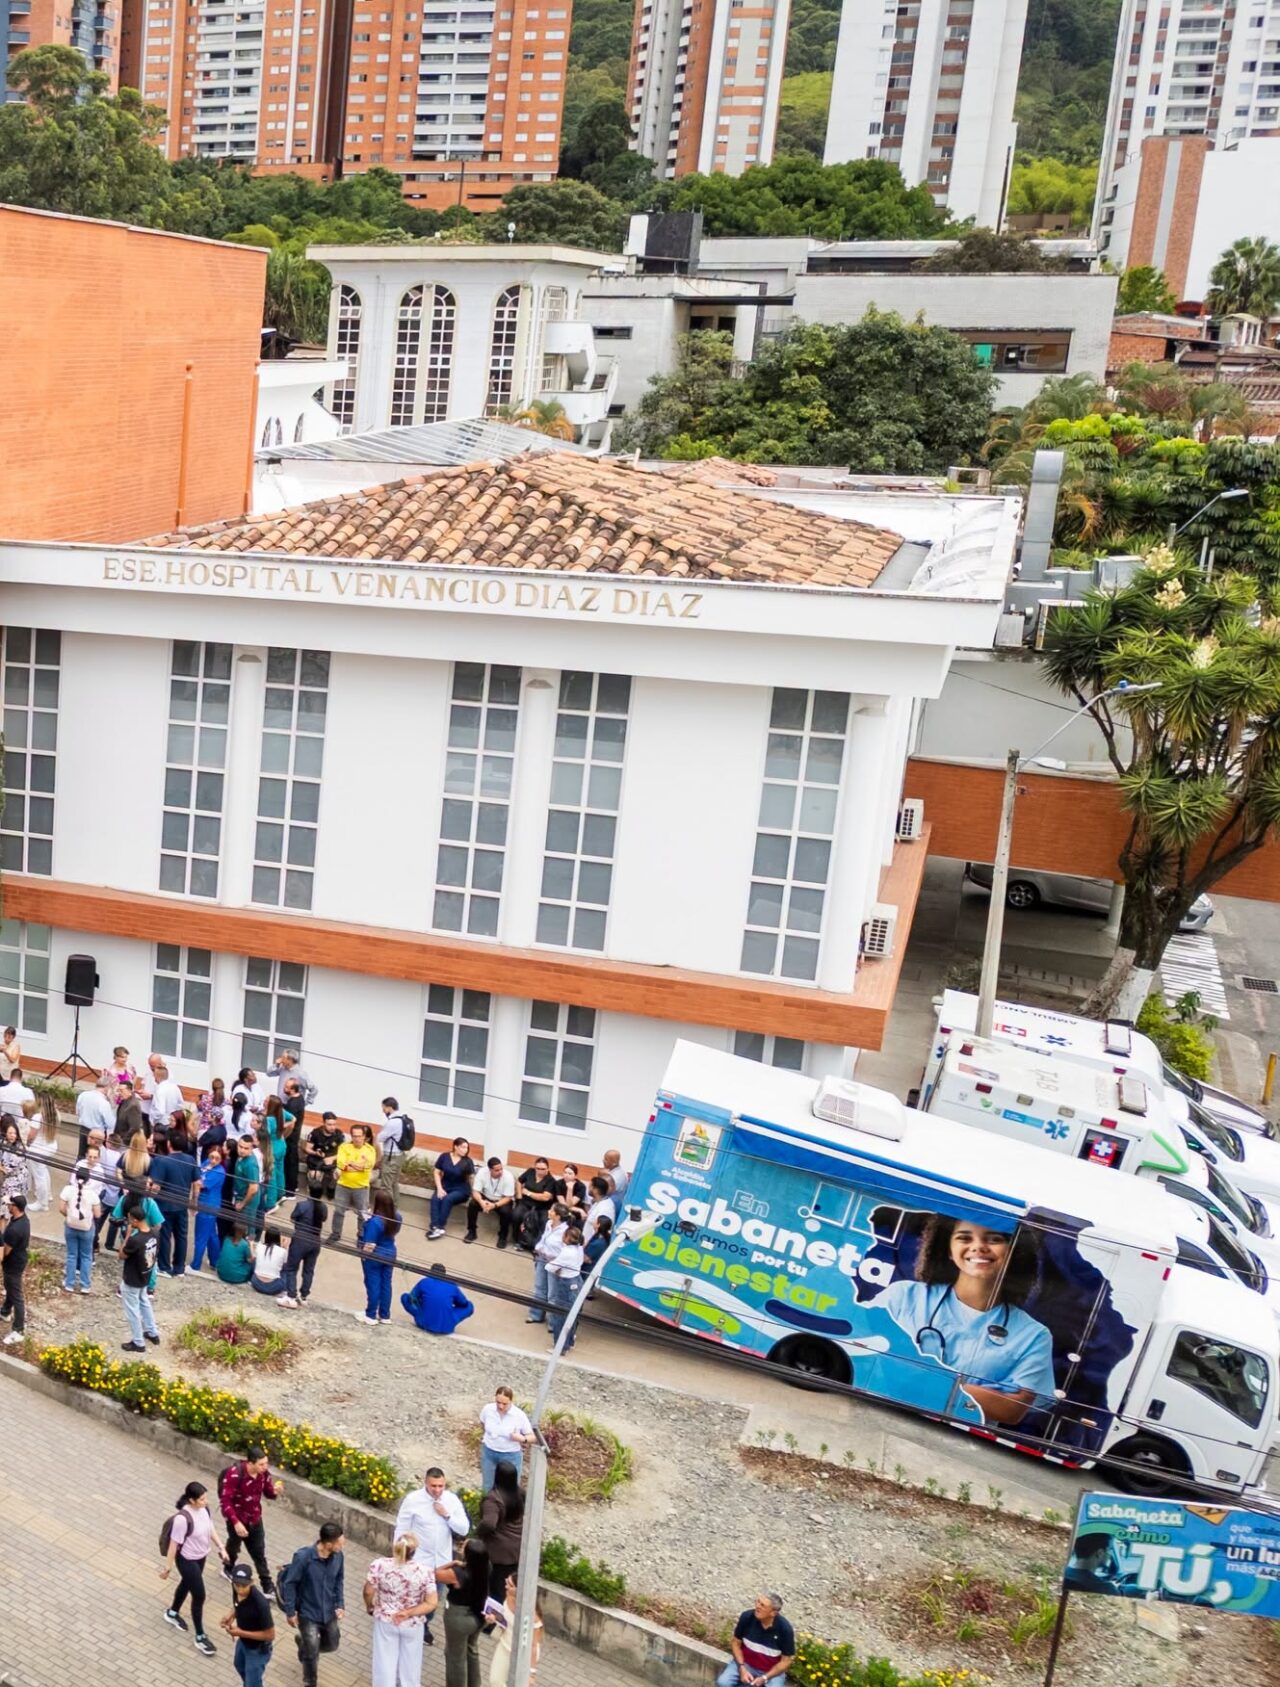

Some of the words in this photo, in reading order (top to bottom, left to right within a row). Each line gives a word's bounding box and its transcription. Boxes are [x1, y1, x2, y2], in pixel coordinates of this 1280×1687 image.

[331, 571, 507, 604] VENANCIO
[515, 582, 603, 612] DIAZ
[612, 588, 704, 618] DIAZ
[731, 1189, 770, 1219] En
[645, 1181, 896, 1288] Sabaneta
[638, 1228, 839, 1313] bienestar
[751, 1250, 786, 1272] por
[786, 1258, 809, 1278] tu
[1088, 1503, 1184, 1526] Sabaneta
[1226, 1546, 1254, 1562] un
